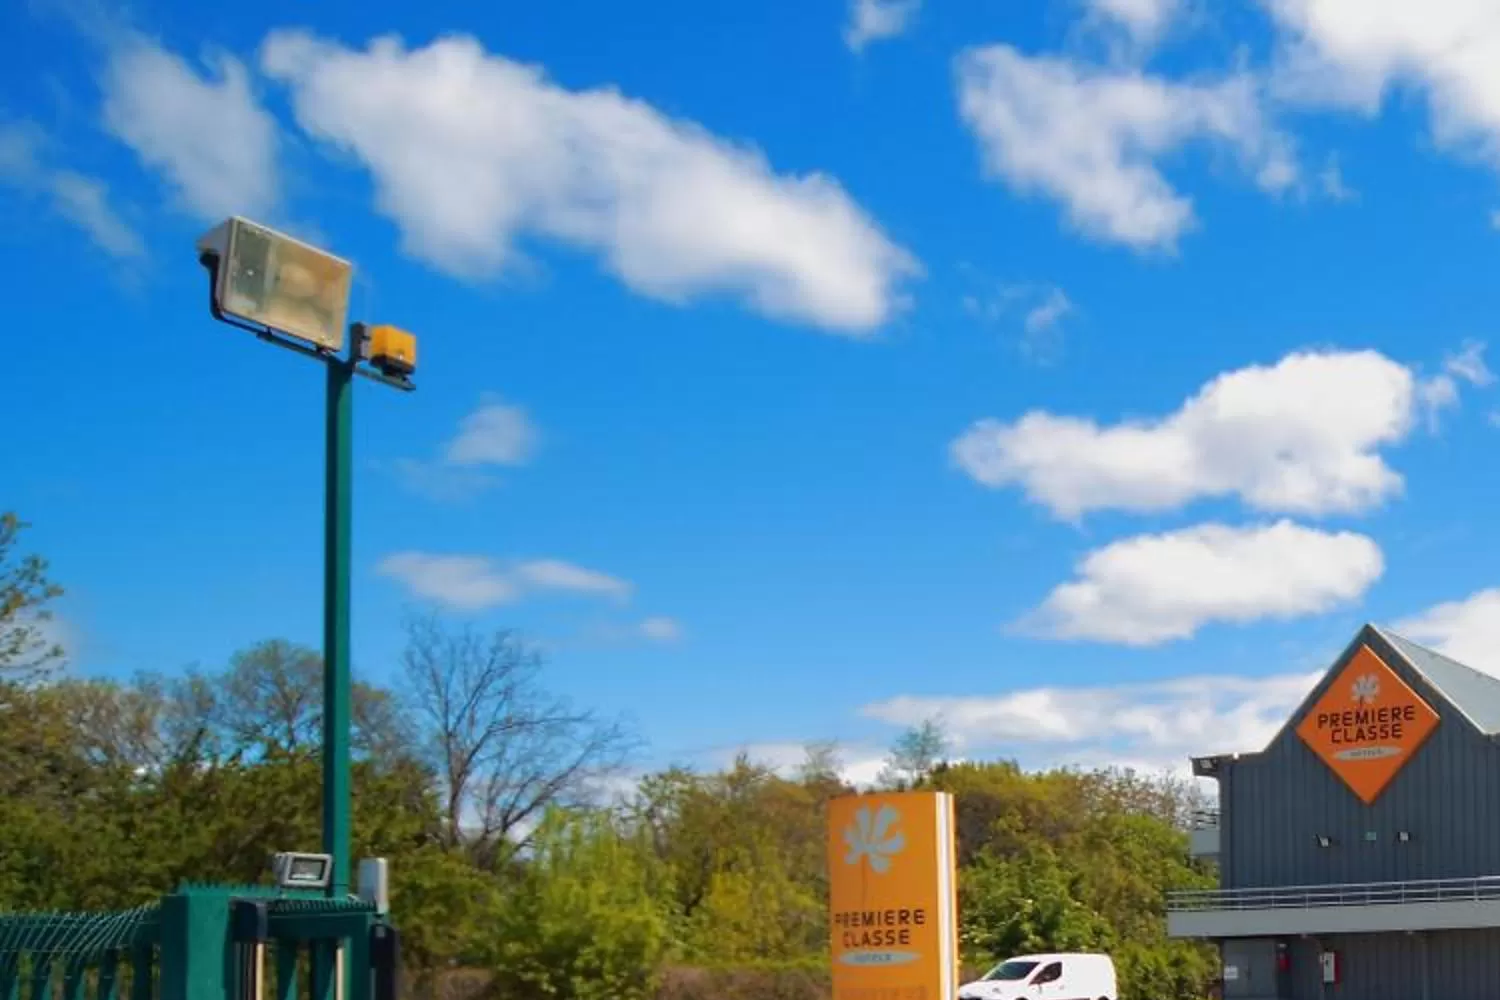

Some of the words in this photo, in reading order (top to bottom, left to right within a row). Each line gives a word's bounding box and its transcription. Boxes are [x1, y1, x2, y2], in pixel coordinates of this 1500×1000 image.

[1317, 705, 1416, 729] PREMIERE
[1331, 723, 1403, 744] CLASSE
[844, 928, 911, 949] CLASSE
